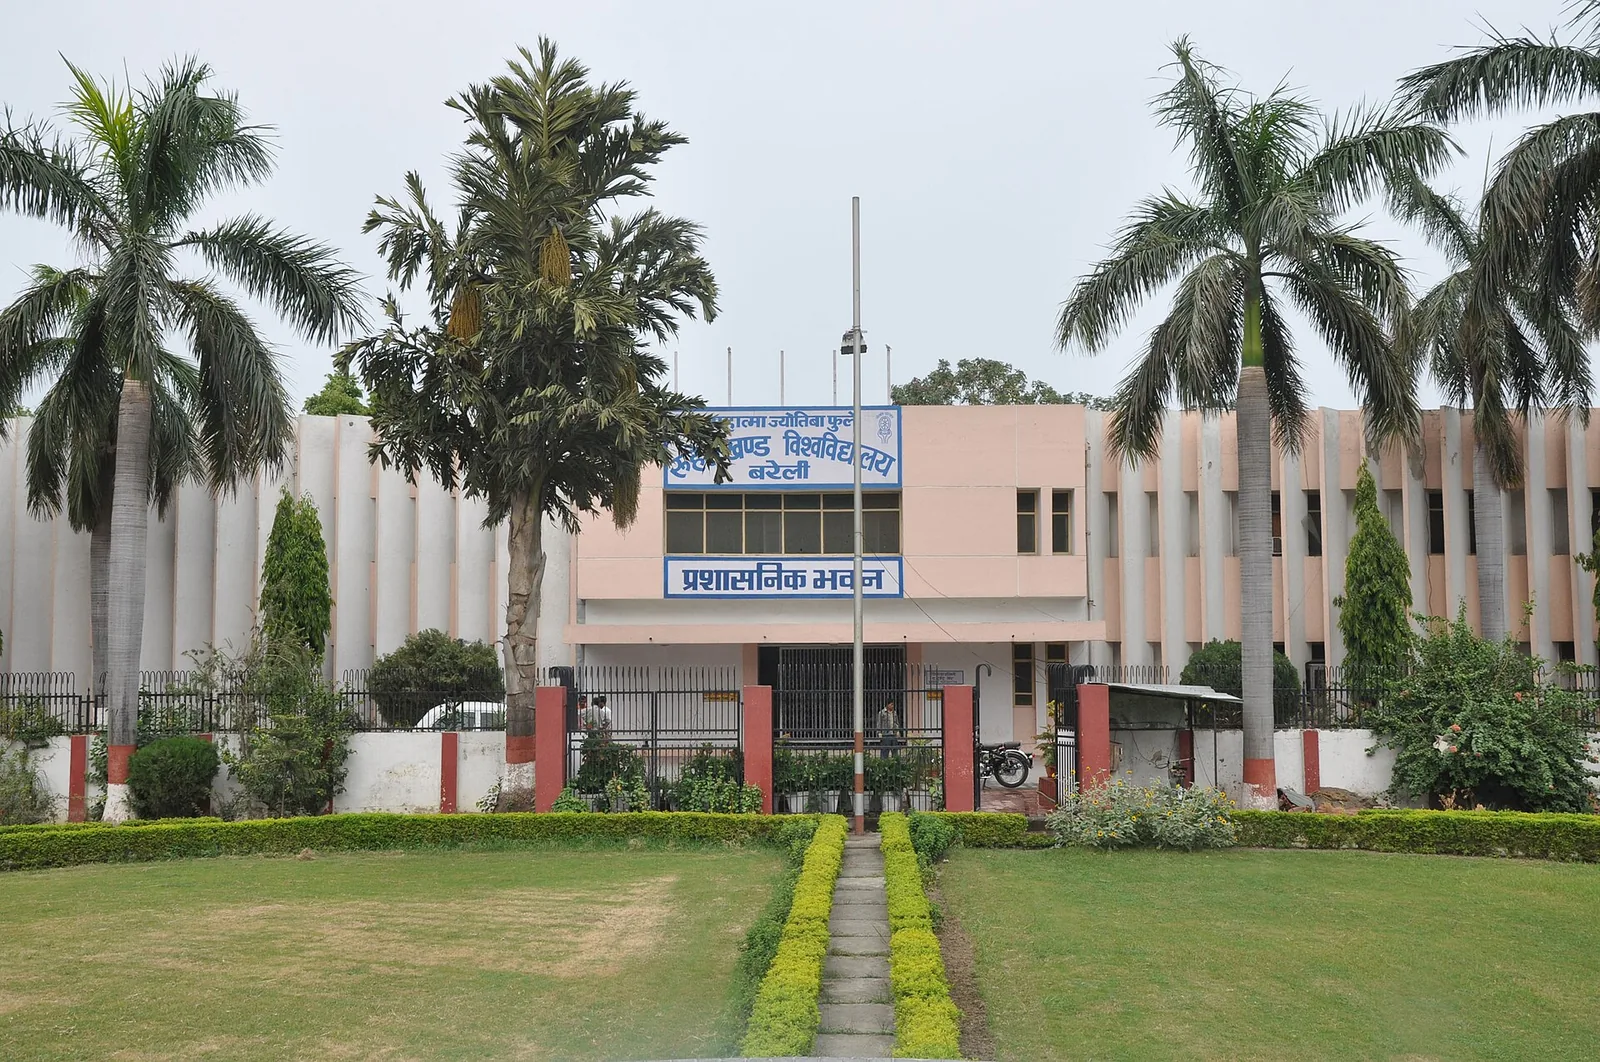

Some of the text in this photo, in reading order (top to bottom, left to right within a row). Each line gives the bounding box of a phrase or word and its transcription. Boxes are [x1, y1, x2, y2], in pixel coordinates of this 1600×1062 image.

[768, 410, 826, 427] ज्योतिबा
[748, 460, 811, 480] बरेली
[681, 562, 885, 591] प्रशासनिक भवन
